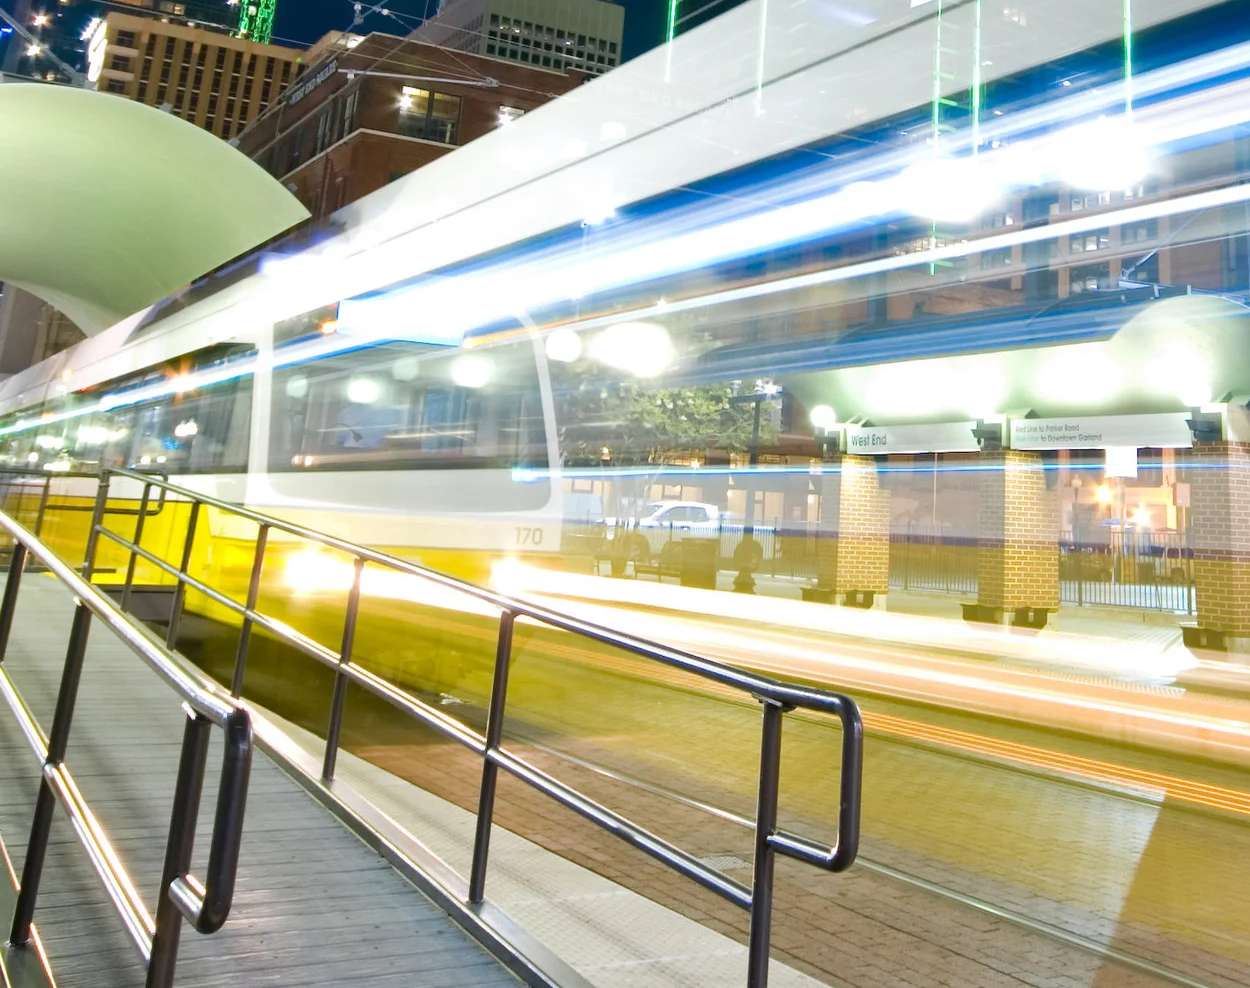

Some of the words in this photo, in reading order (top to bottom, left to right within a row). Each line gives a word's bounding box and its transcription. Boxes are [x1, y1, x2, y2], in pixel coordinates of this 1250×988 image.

[851, 435, 870, 446] West
[871, 434, 887, 445] End
[1047, 434, 1077, 442] Downtown
[515, 527, 543, 546] 170
